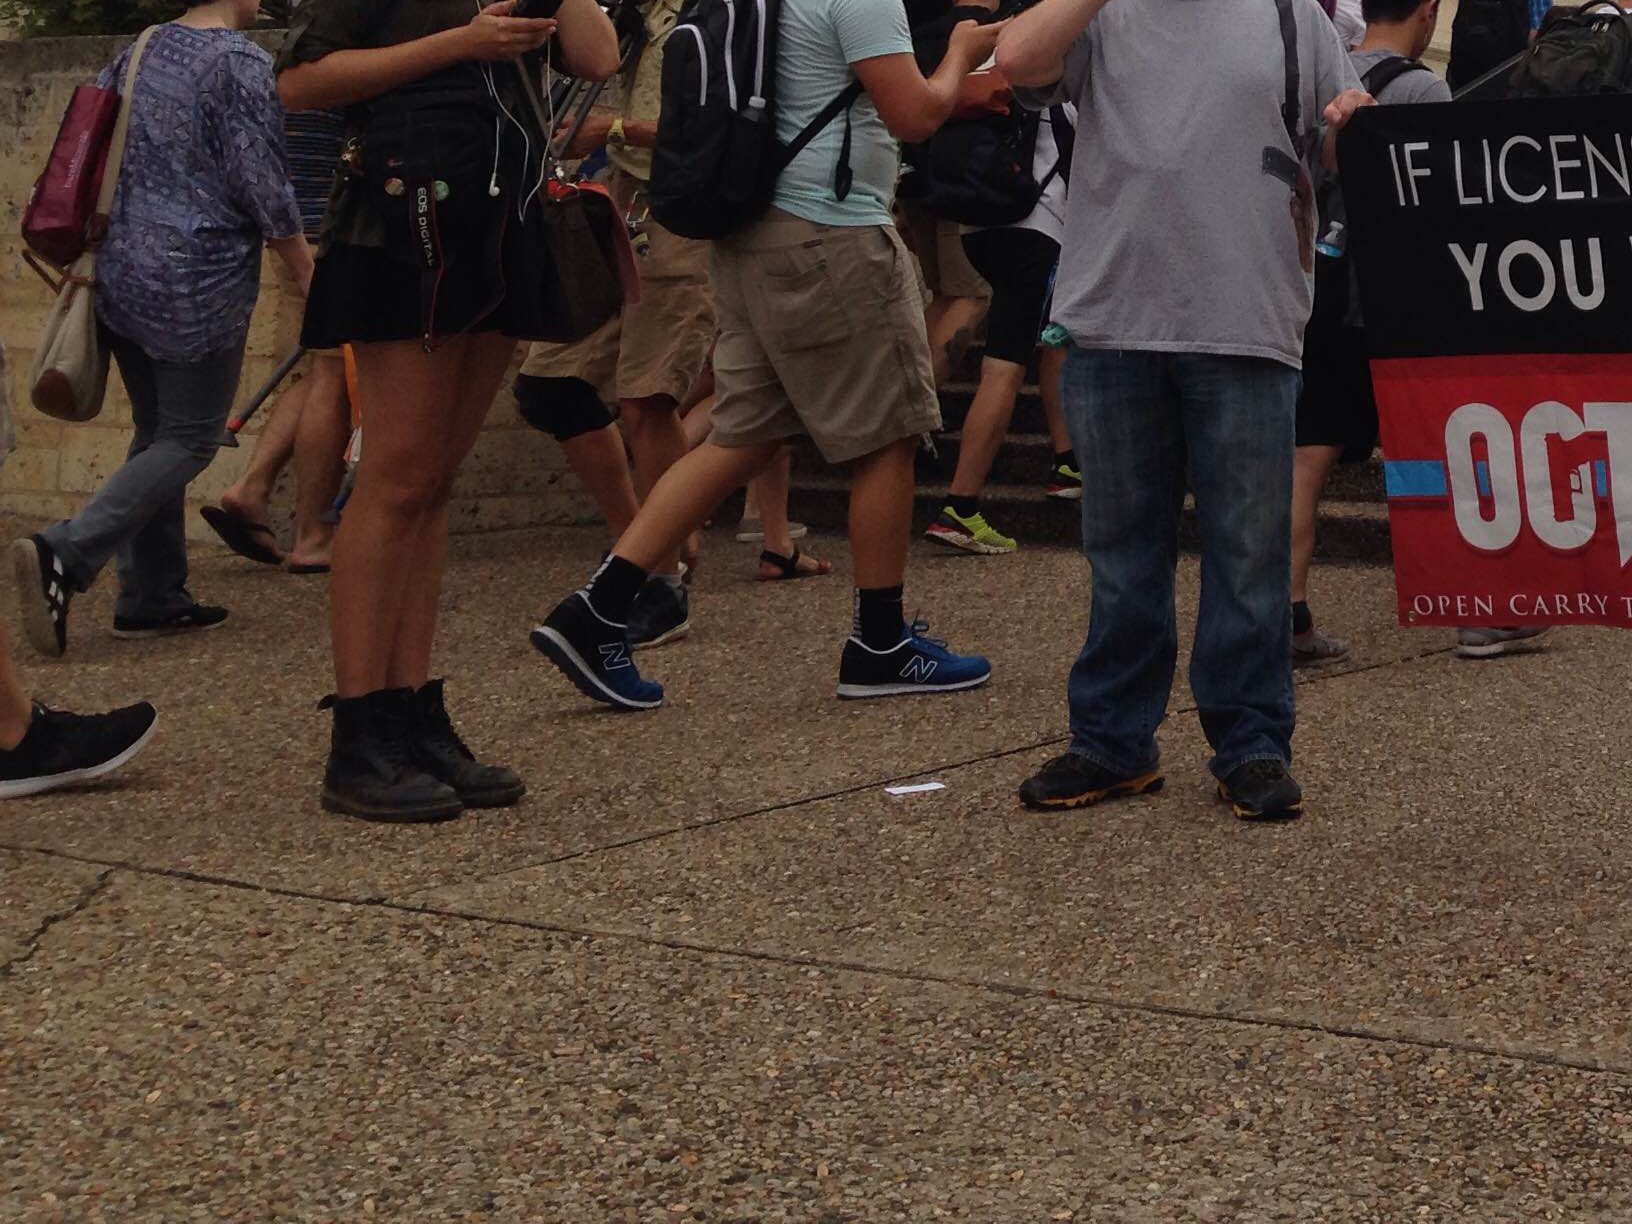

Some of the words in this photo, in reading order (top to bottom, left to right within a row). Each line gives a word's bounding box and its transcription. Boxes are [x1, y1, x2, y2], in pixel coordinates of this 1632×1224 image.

[1388, 140, 1432, 206] IF
[417, 186, 428, 214] EOS
[1448, 236, 1606, 312] YOU
[1413, 594, 1494, 617] OPEN
[1509, 592, 1609, 617] CARRY
[898, 655, 938, 683] N
